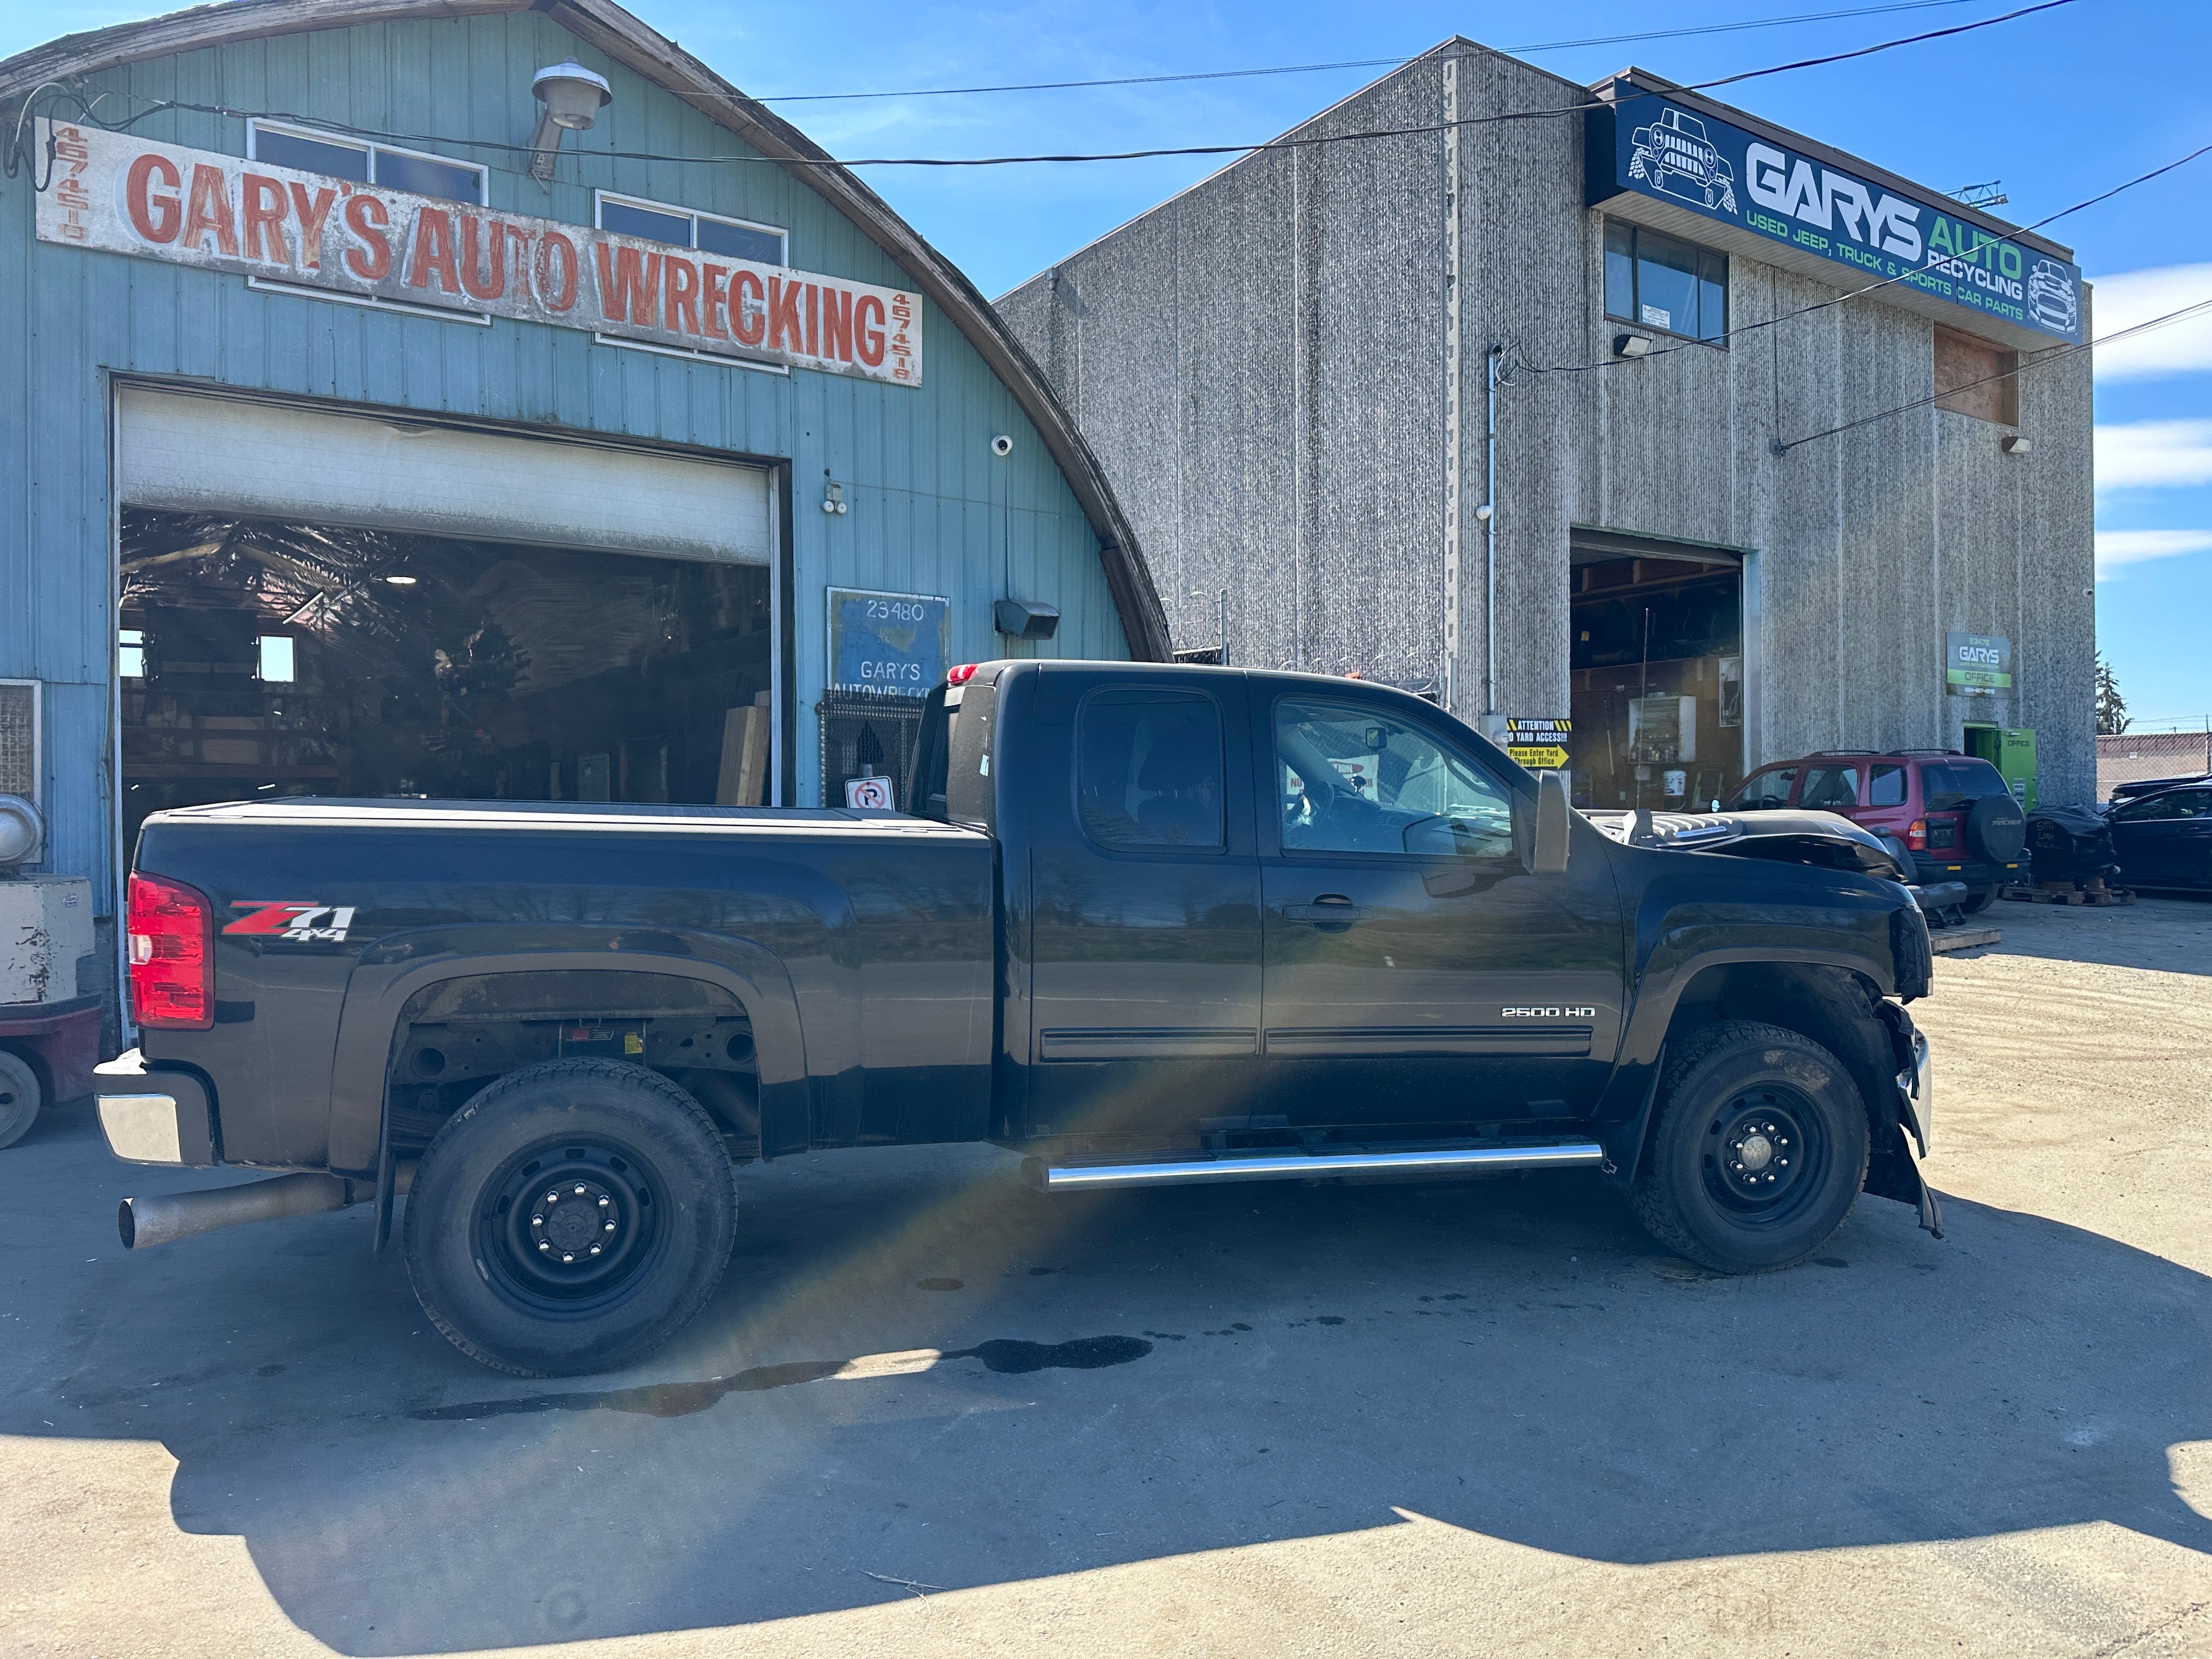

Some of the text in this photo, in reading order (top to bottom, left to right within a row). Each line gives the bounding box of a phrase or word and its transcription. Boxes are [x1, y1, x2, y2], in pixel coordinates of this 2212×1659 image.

[1747, 142, 1922, 262] GARYS
[1928, 215, 2022, 280] AUTO
[126, 153, 886, 367] GARY'S AUTO WRECKING
[1746, 210, 2023, 320] USED JEEP, TRUCK & SPORTS CAR PARTS
[1927, 249, 2023, 301] RECYCLING
[866, 599, 924, 622] 23480
[1959, 646, 1999, 664] GARYS
[861, 661, 921, 681] GARY'S
[1964, 672, 1995, 683] OFFICE
[1517, 720, 1554, 730] ATTENTION
[1516, 732, 1534, 743] YARD
[1536, 732, 1567, 743] ACCESS!!!
[1509, 749, 1559, 757] Please Enter Yard
[1514, 757, 1536, 766] Through
[221, 900, 357, 935] Z71
[1501, 1007, 1596, 1017] 2500 HD
